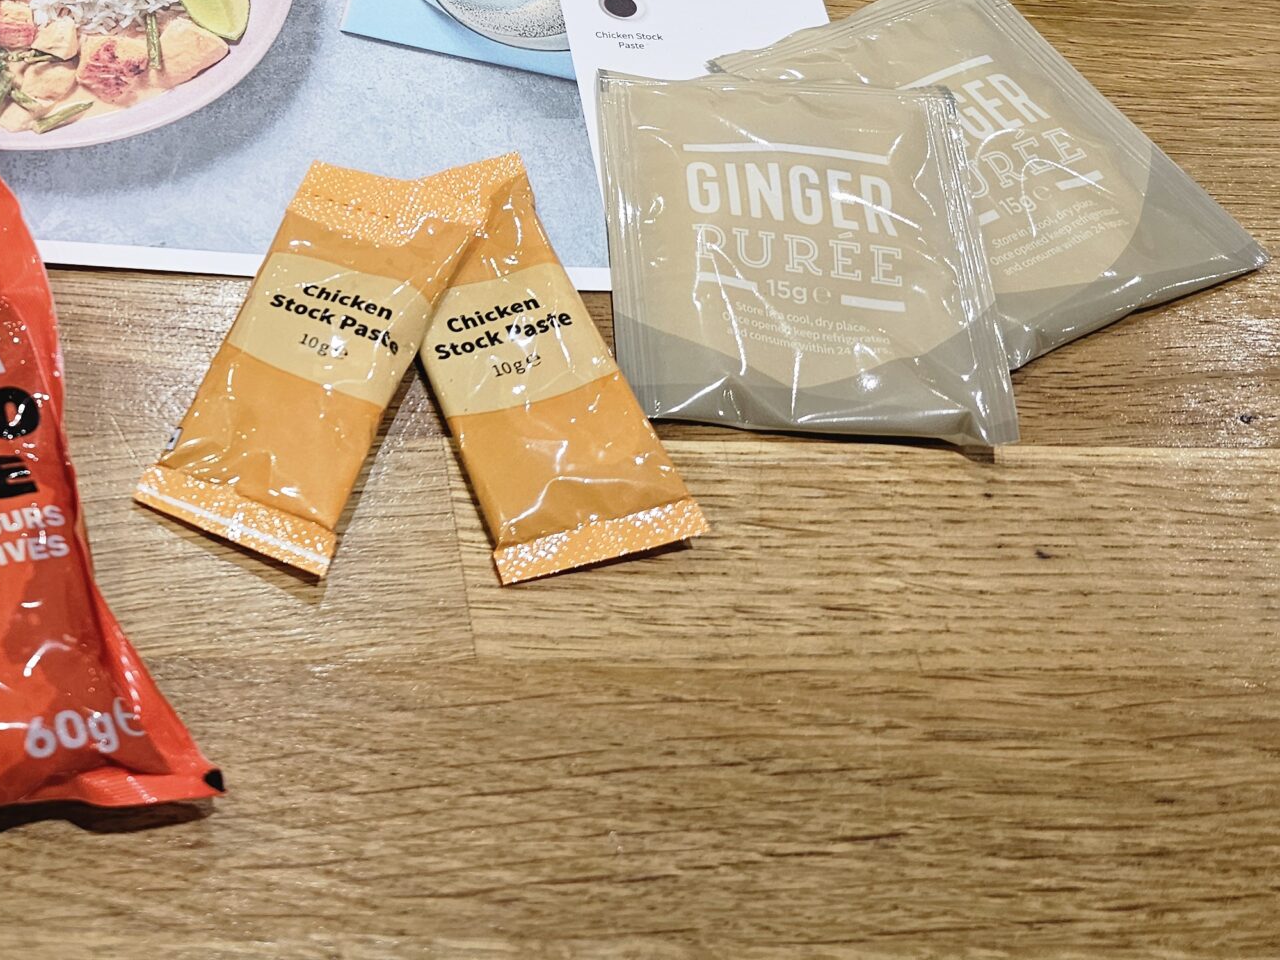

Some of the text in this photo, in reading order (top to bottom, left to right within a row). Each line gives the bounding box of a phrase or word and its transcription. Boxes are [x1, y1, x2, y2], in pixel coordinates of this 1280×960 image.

[595, 31, 664, 41] Chicken Stock
[618, 41, 645, 49] Paste
[685, 161, 898, 238] GINGER
[999, 195, 1037, 216] 15g
[989, 224, 1072, 266] Once opened keep
[992, 231, 1018, 249] Store
[1056, 207, 1074, 224] dry
[692, 223, 903, 287] PURÉE
[1002, 222, 1105, 277] and consume within 24
[302, 283, 394, 321] Chicken
[766, 279, 808, 305] 15g
[269, 293, 337, 326] Stock
[338, 314, 400, 357] Paste
[446, 296, 541, 334] Chicken
[722, 311, 750, 326] Oce
[793, 326, 820, 340] keep
[735, 301, 764, 317] Store
[787, 311, 815, 327] cool,
[815, 317, 834, 331] dry
[836, 321, 870, 334] place.
[434, 309, 574, 361] Stock Paste
[797, 340, 835, 355] within
[837, 346, 851, 355] 24
[491, 357, 526, 378] 10g
[24, 709, 120, 760] 60g
